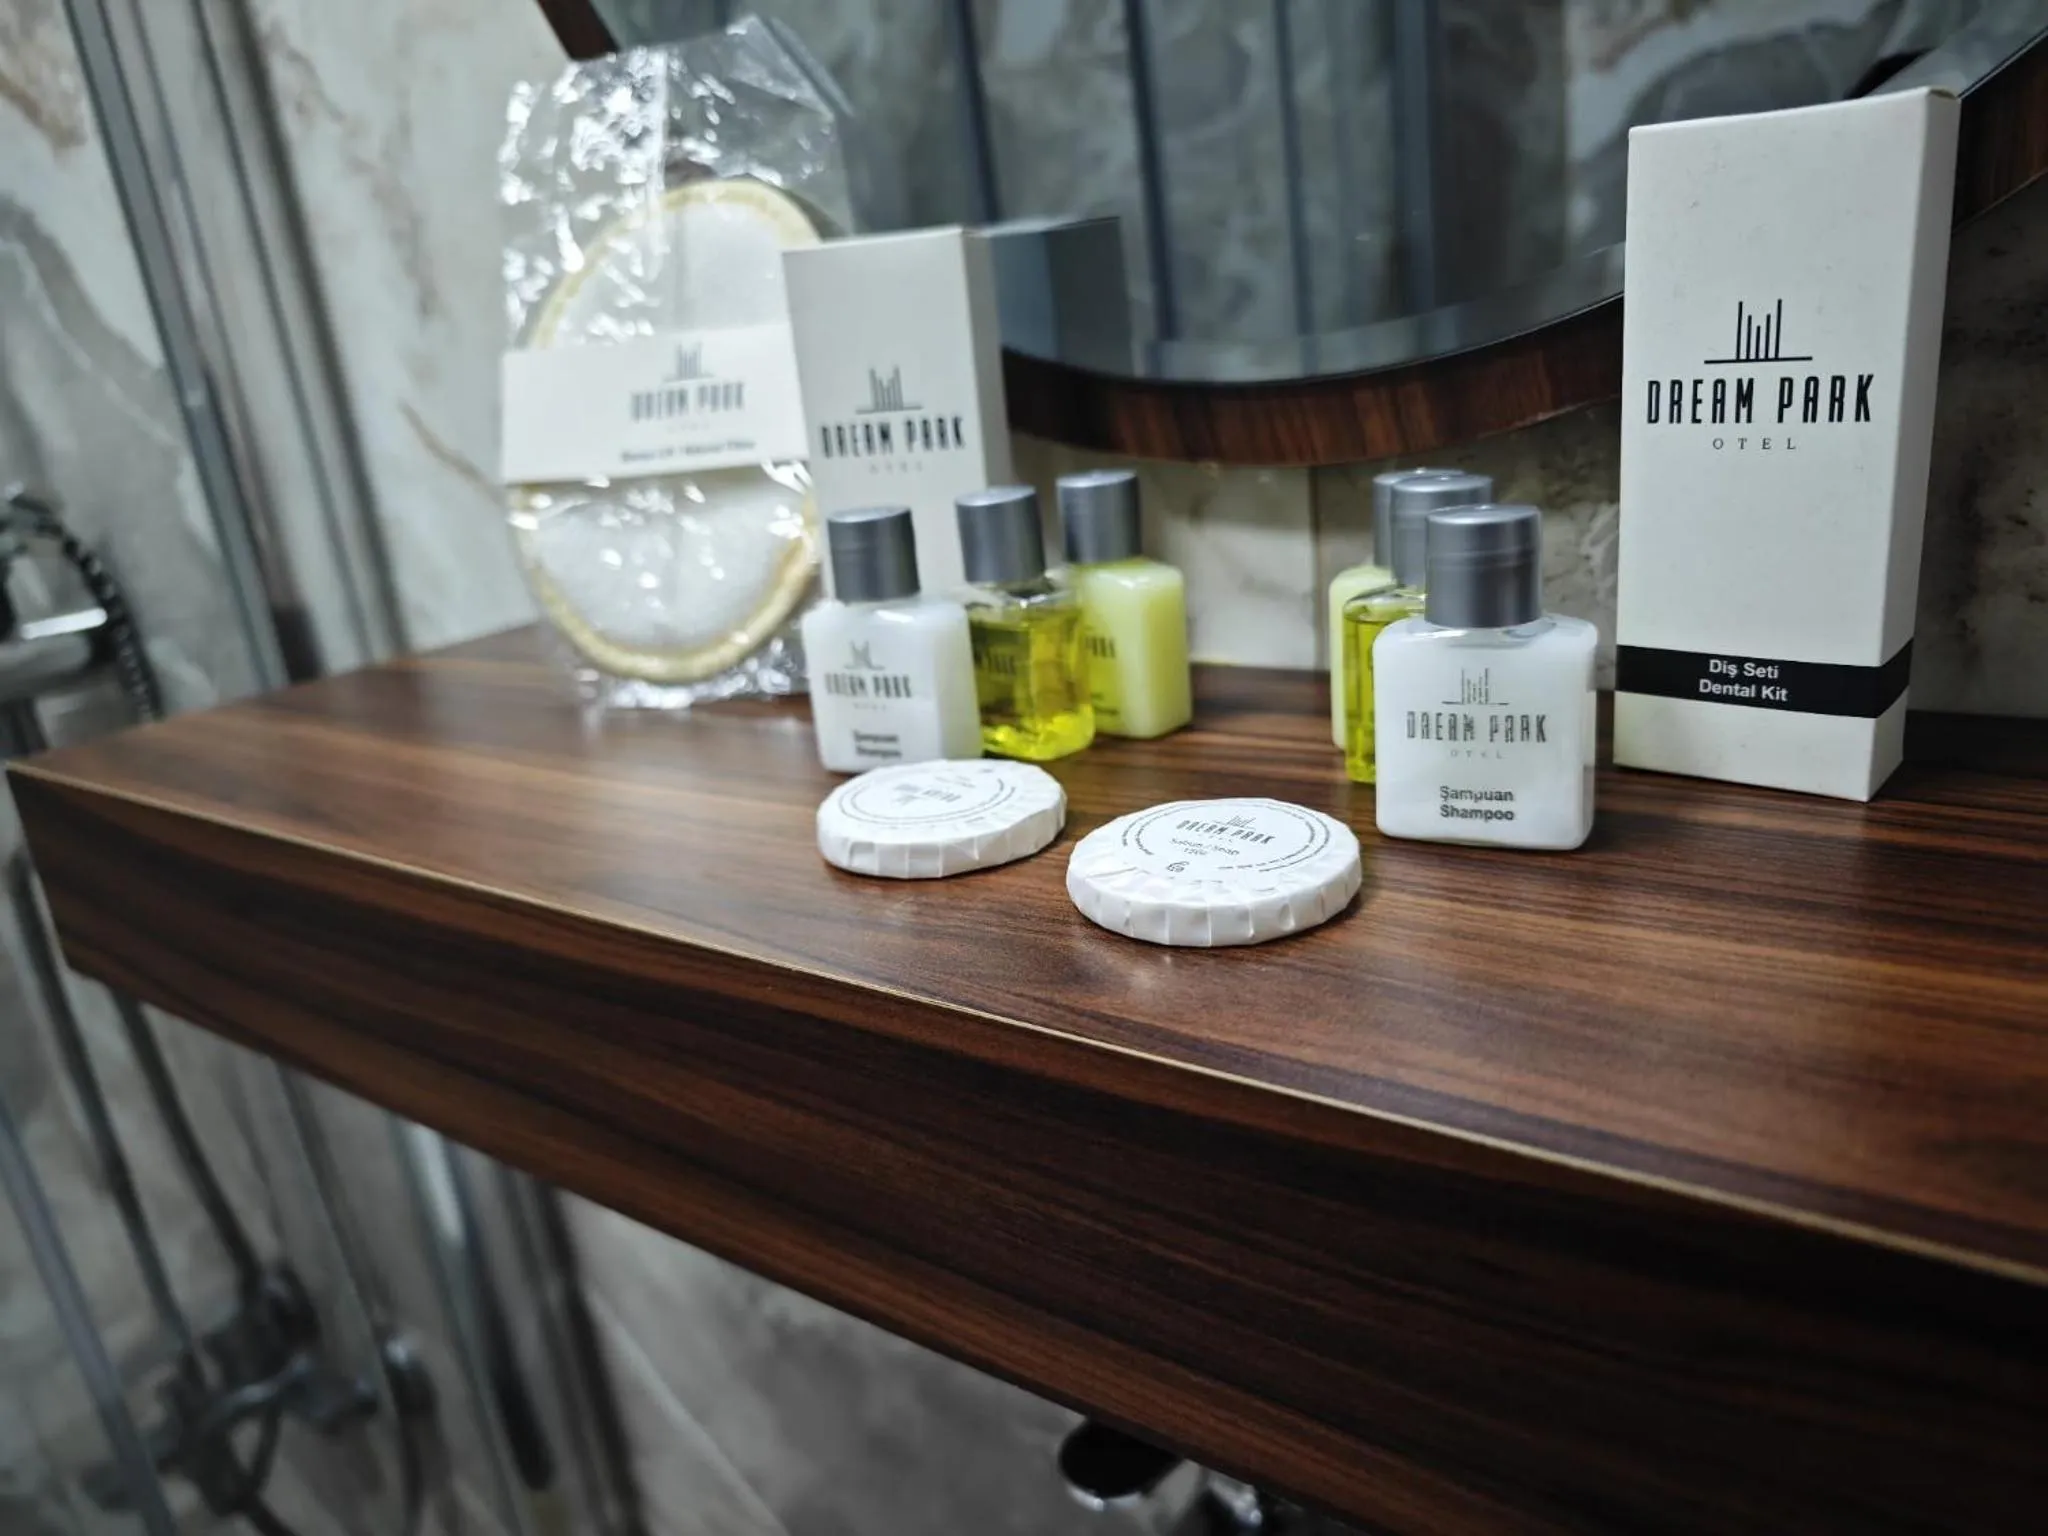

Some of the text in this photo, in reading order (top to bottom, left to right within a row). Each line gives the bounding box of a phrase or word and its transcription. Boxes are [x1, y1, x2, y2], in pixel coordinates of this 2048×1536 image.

[1647, 373, 1874, 424] DREAM PARK
[819, 416, 965, 458] DREAM PARK
[1712, 437, 1797, 450] OTEL
[1708, 658, 1780, 680] Diş Seti
[1699, 678, 1788, 701] Dental Kit
[1406, 711, 1549, 743] DREAM PARK
[1439, 785, 1514, 804] Şampuan
[1439, 803, 1515, 822] Shampoo
